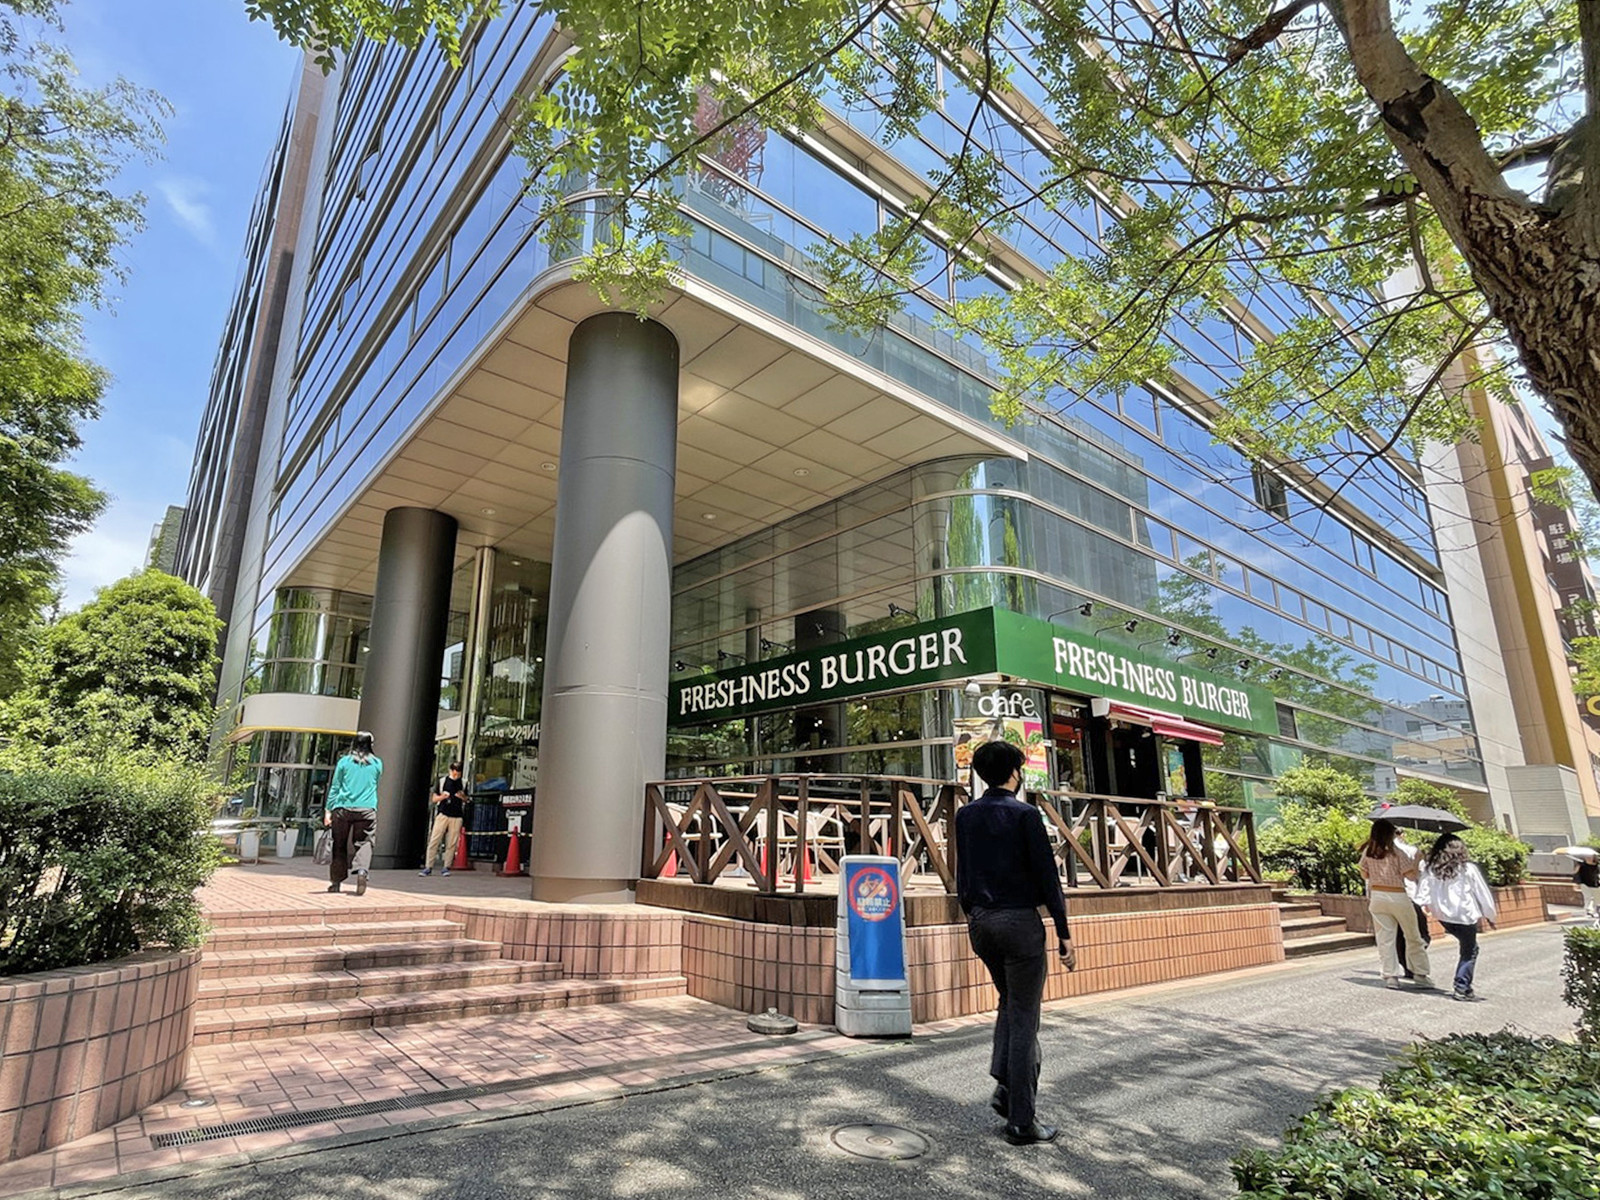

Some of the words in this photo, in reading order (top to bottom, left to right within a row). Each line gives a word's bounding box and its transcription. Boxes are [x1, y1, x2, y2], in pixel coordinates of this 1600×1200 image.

[1548, 523, 1573, 565] 駐車場
[680, 660, 811, 715] FRESHNESS
[820, 627, 968, 689] BURGER
[1052, 637, 1177, 702] FRESHNESS
[1180, 675, 1253, 721] BURGER
